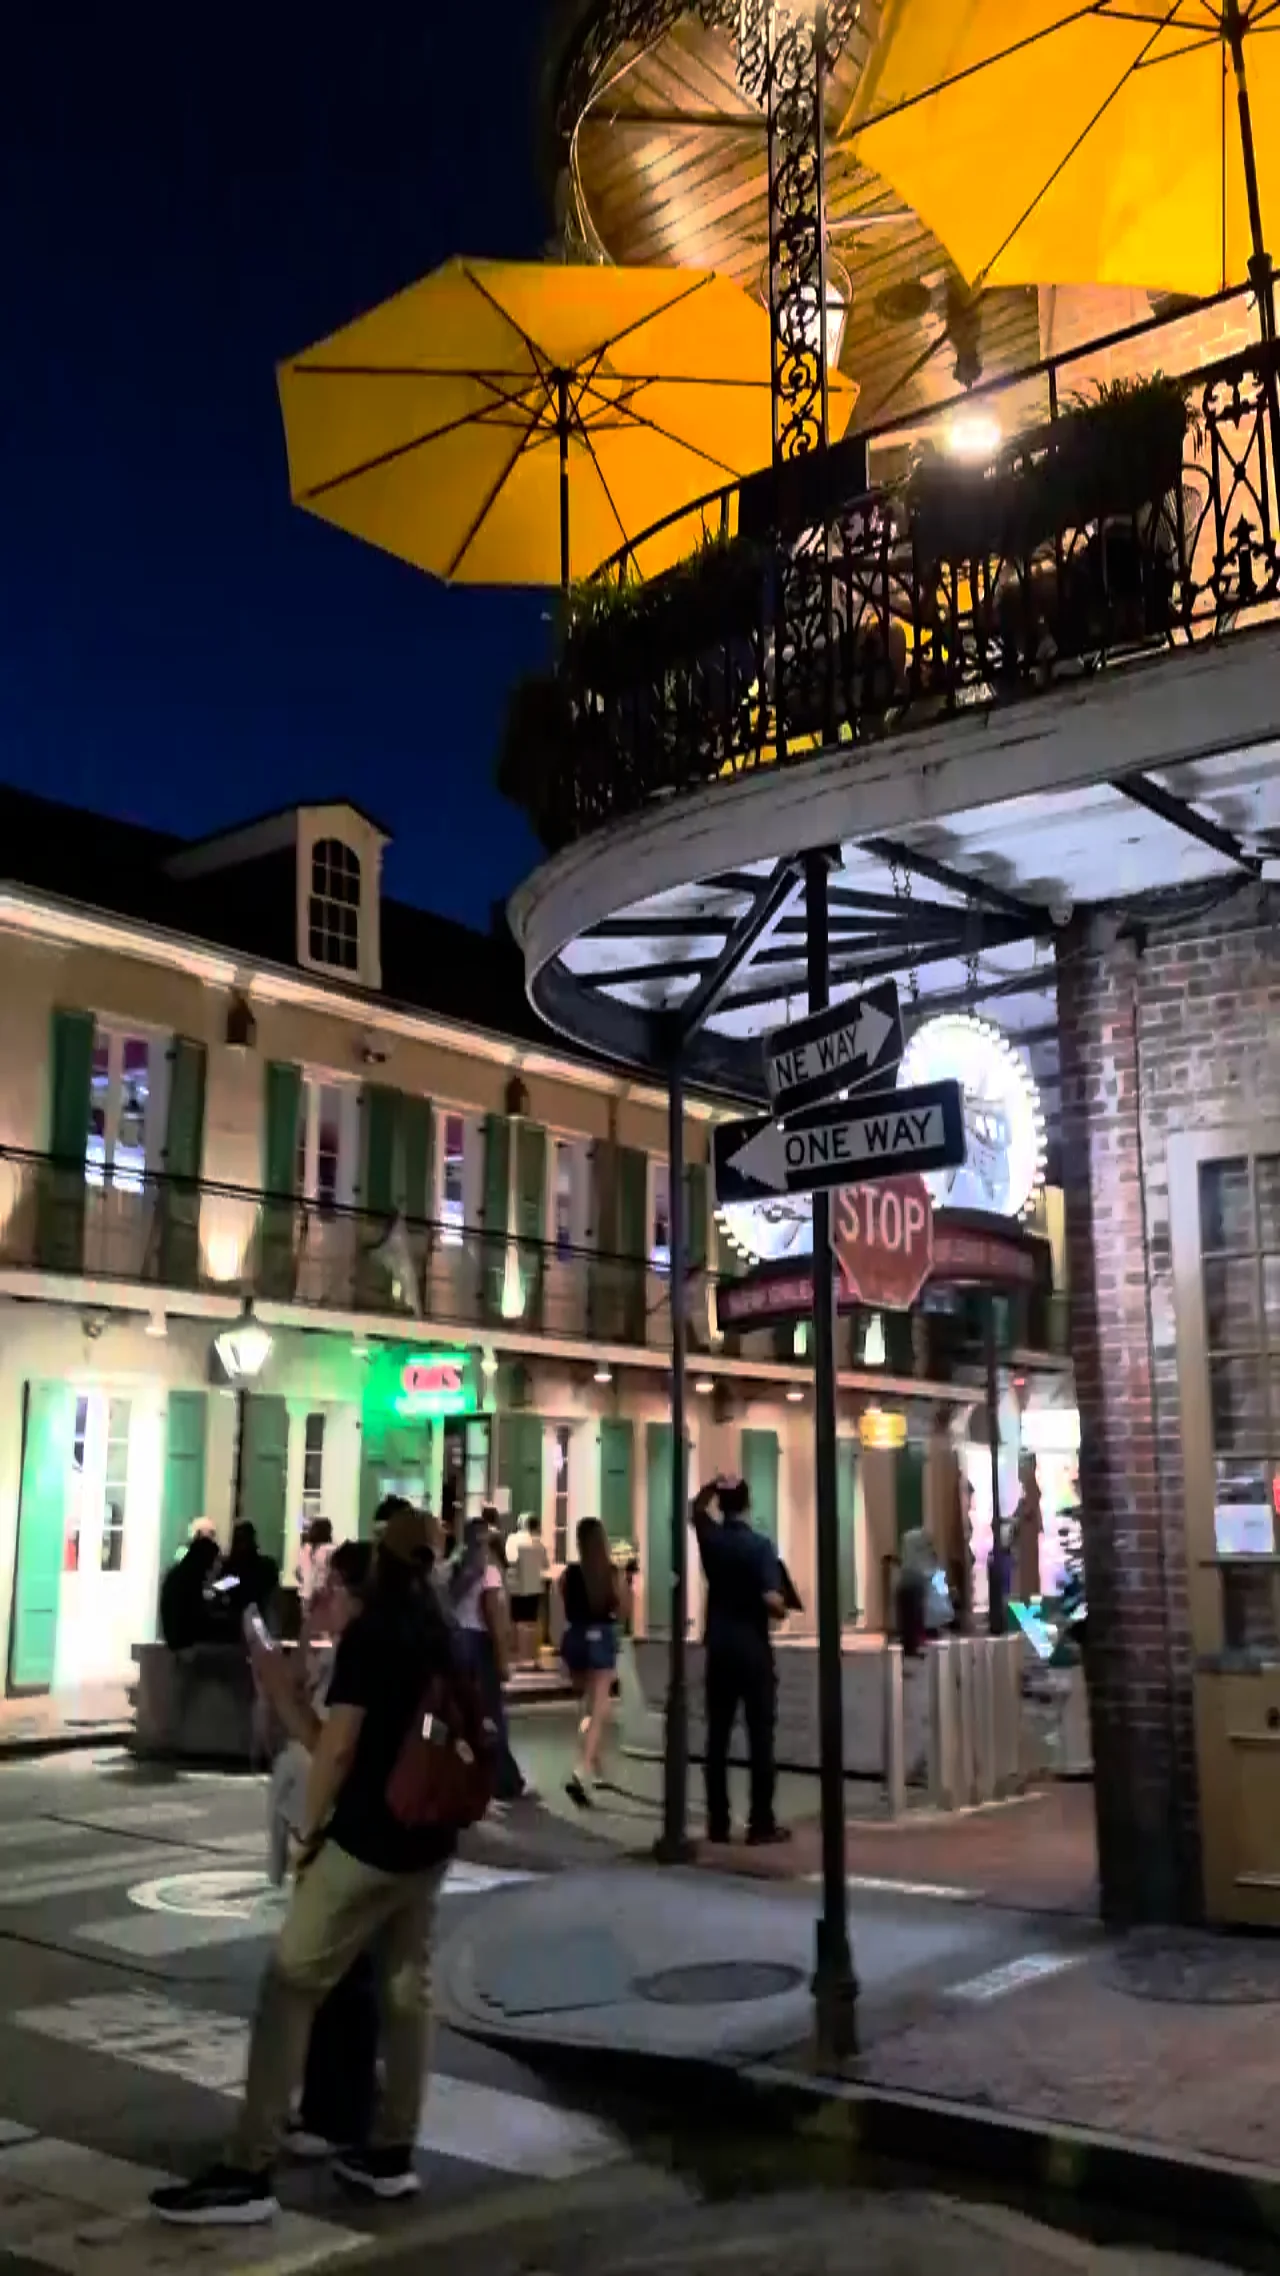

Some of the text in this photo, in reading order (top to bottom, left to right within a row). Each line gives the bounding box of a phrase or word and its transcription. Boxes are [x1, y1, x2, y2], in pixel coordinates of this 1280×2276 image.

[774, 1022, 857, 1090] NE WAY
[785, 1110, 932, 1165] ONE WAY
[838, 1184, 925, 1256] STOP
